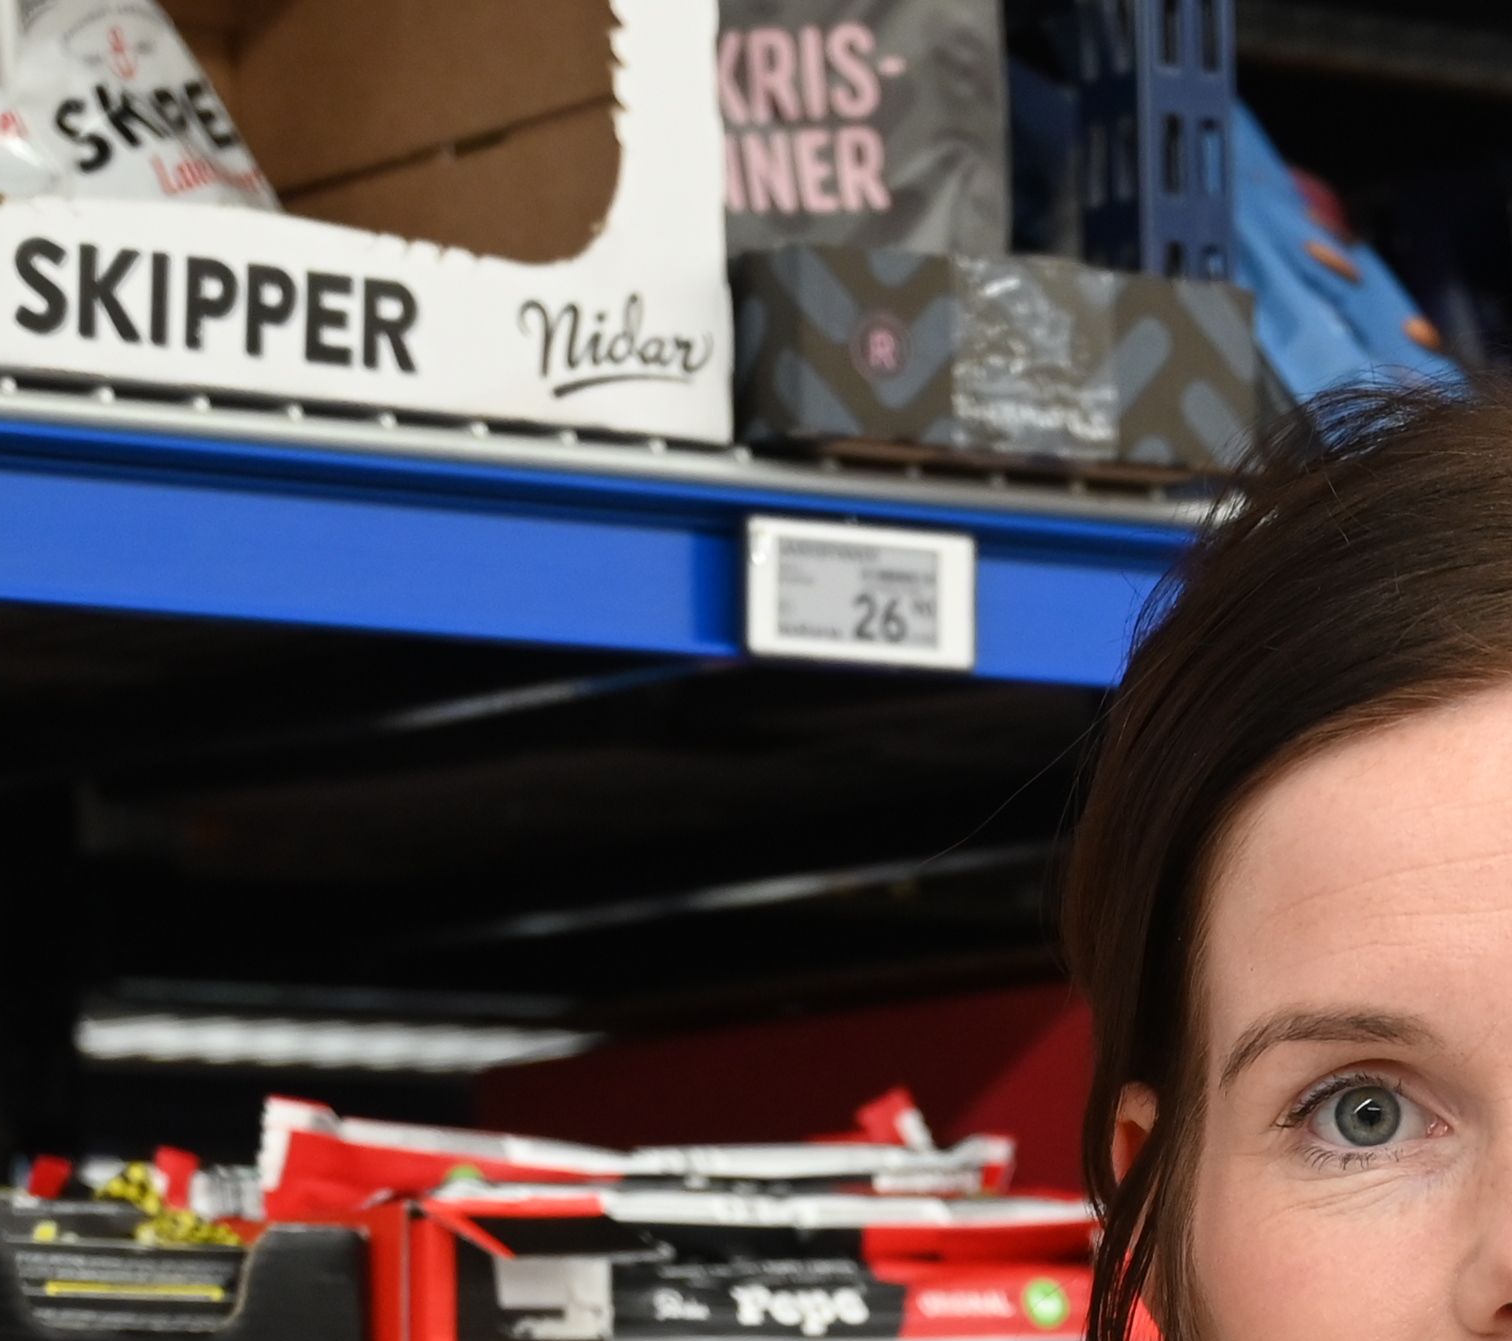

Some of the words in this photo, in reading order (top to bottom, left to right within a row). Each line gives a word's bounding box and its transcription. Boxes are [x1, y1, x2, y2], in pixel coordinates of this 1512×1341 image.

[14, 236, 420, 374] SKIPPER
[519, 295, 713, 380] Nidar
[853, 593, 906, 643] 26
[730, 1285, 870, 1336] Pepe
